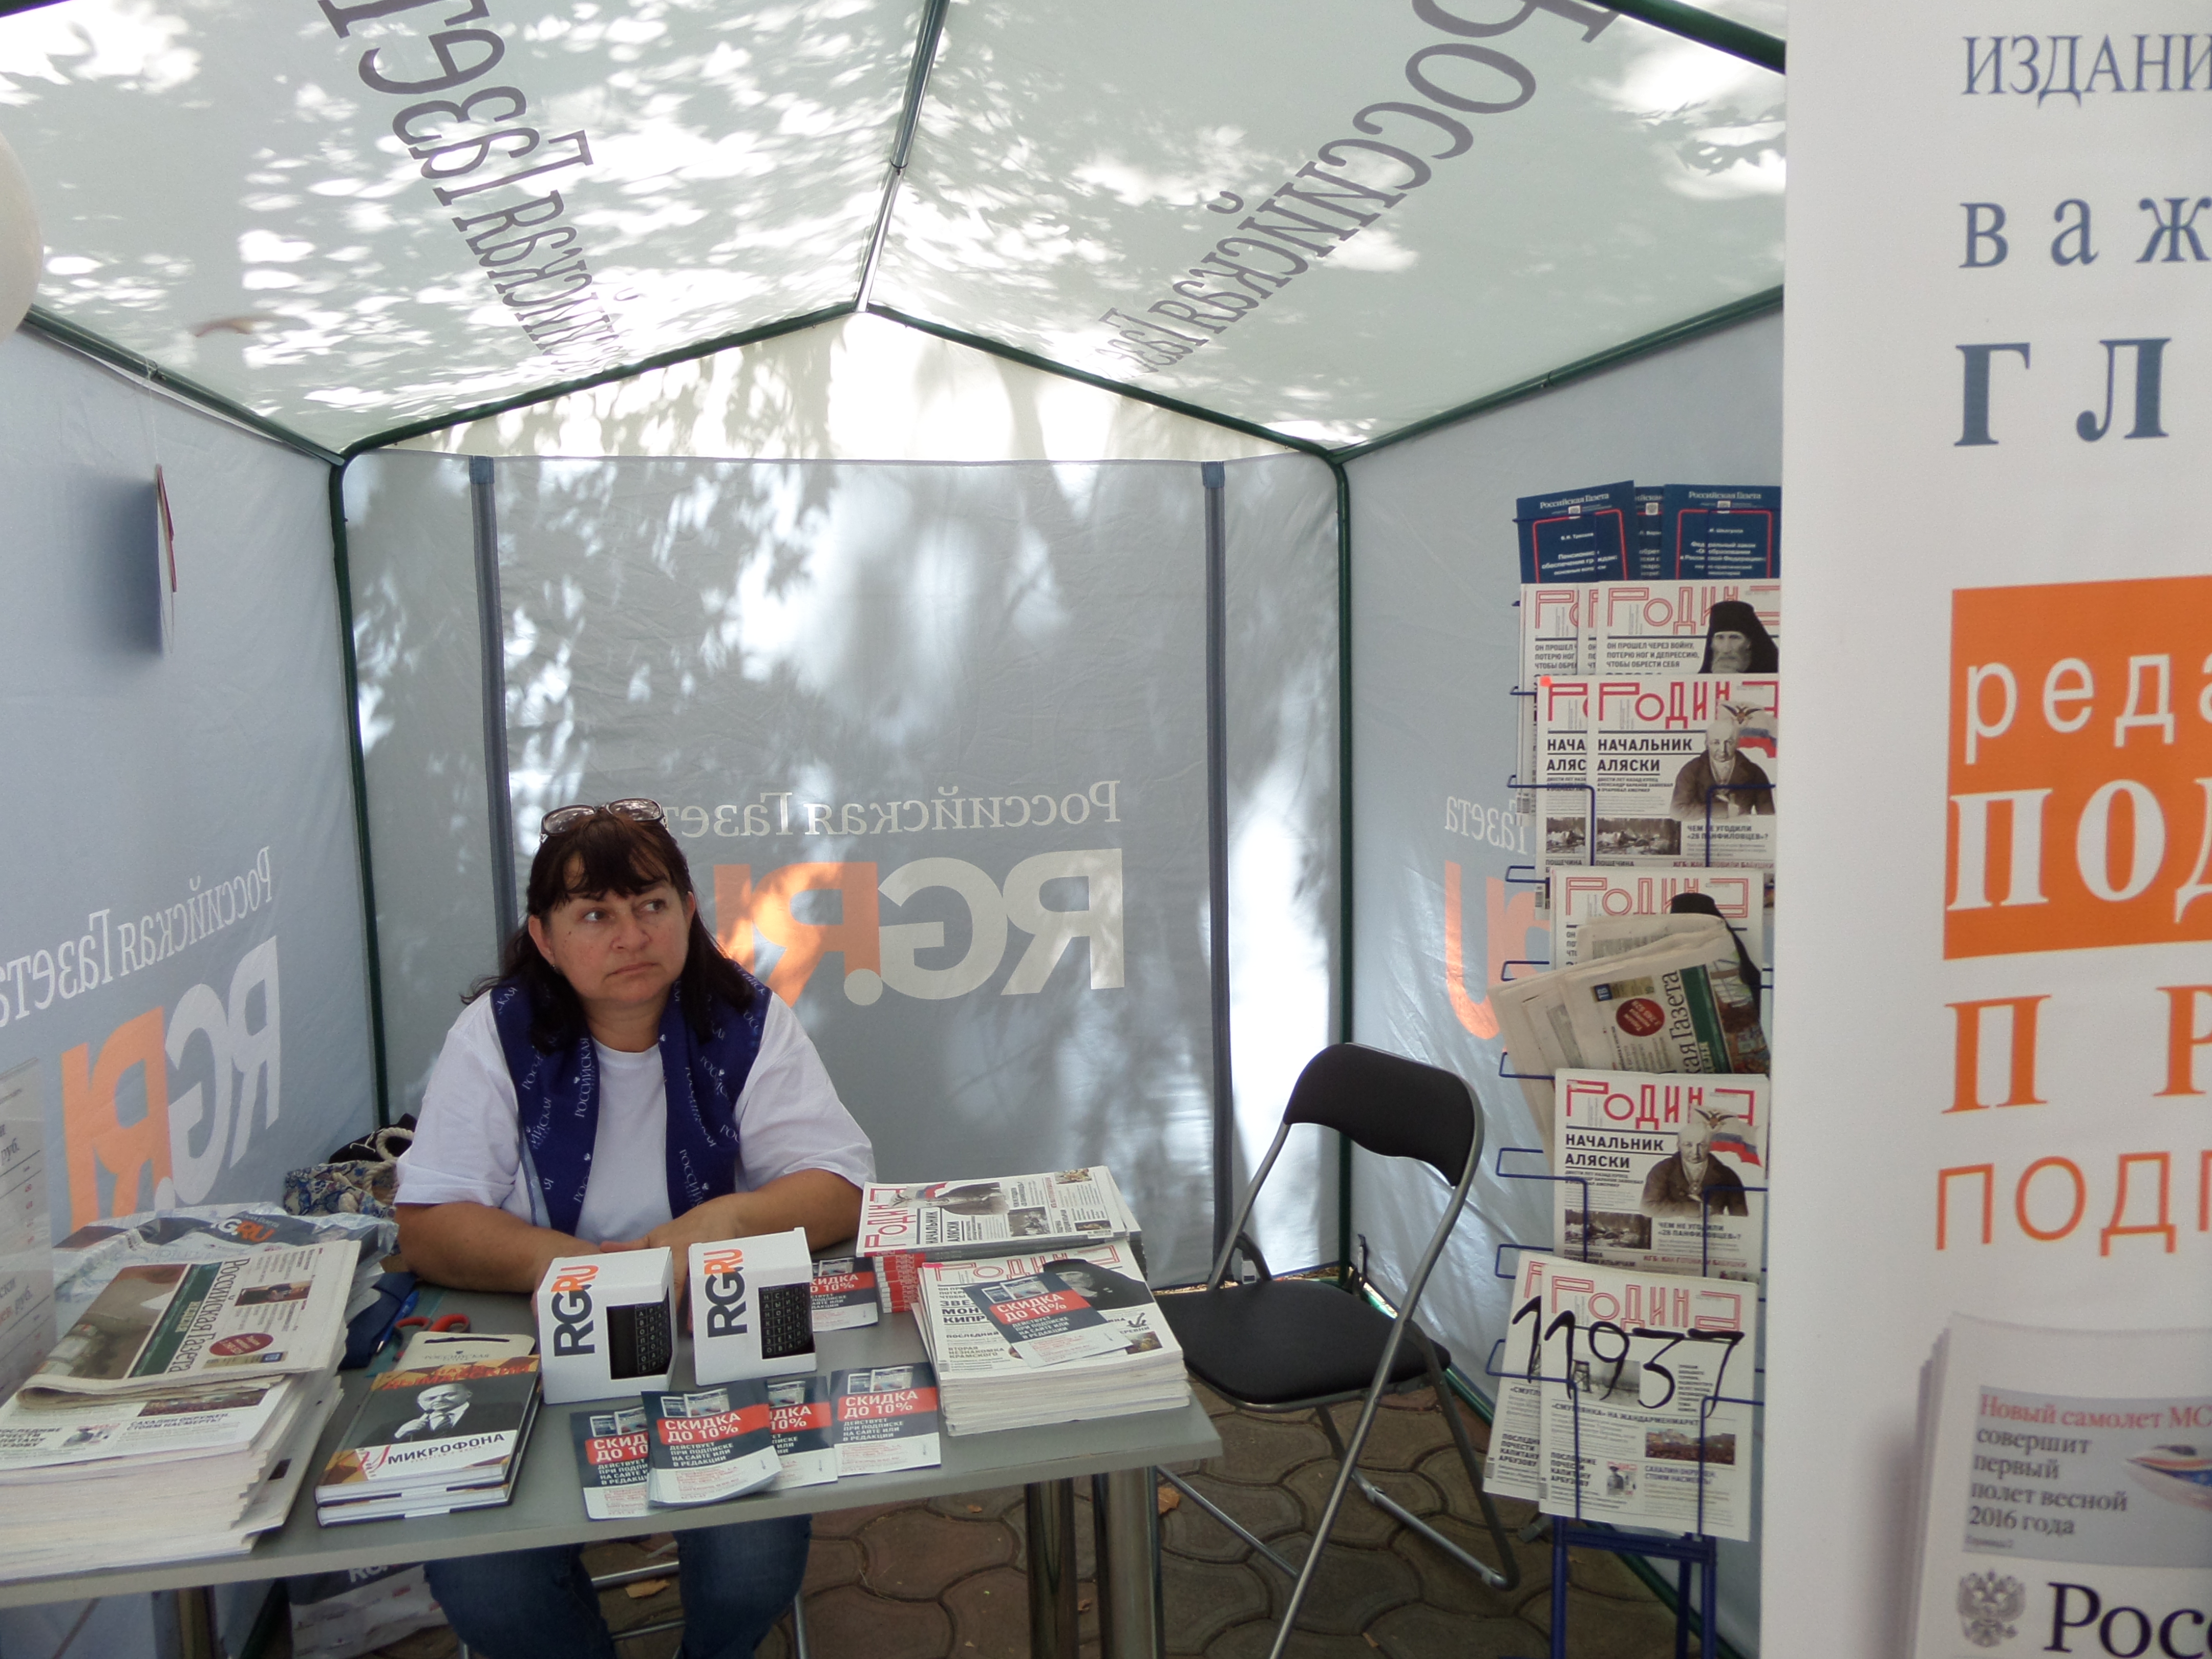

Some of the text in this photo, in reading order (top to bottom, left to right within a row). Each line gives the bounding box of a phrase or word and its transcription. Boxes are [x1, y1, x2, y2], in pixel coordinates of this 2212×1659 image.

[1598, 738, 1693, 752] НАЧАЛЬНИК
[1597, 759, 1661, 772] АЛЯСКИ
[1662, 970, 1693, 1040] Газета
[1565, 1133, 1664, 1152] НАЧАЛЬНИК
[1564, 1153, 1631, 1169] АЛЯСКИ
[925, 1210, 939, 1245] НАЧАЛЬНИК
[947, 1220, 960, 1243] АЛЯСКИ
[190, 1258, 251, 1332] Российская
[823, 1282, 855, 1291] 10%
[997, 1293, 1065, 1313] СКИДКА
[1005, 1302, 1067, 1323] ДО 10%
[1030, 1325, 1052, 1334] САЙТЕ
[1053, 1321, 1070, 1330] ИЛИ
[1032, 1316, 1070, 1328] ПОДПИСКЕ
[1029, 1326, 1068, 1338] РЕДАКЦИИ
[167, 1332, 217, 1373] Газета
[845, 1390, 919, 1407] СКИДКА
[844, 1401, 913, 1419] ДО 10%
[1980, 1393, 2056, 1426] Новый
[2060, 1409, 2163, 1429] самолет
[665, 1411, 741, 1431] СКИДКА
[771, 1417, 807, 1431] 10%
[844, 1418, 888, 1427] ДЕЙСТВУЕТ
[861, 1420, 904, 1430] ПОДПИСКЕ
[668, 1423, 739, 1443] ДО 10%
[850, 1432, 894, 1441] РЕДАКЦИИ
[1975, 1428, 2092, 1456] совершит
[388, 1433, 505, 1465] МИКРОФОНА
[669, 1441, 715, 1451] ДЕЙСТВУЕТ
[690, 1442, 734, 1455] ПОДПИСКЕ
[596, 1450, 623, 1463] ДО
[680, 1456, 727, 1466] РЕДАКЦИИ
[685, 1452, 713, 1460] САЙТЕ
[1973, 1454, 2059, 1480] первый
[1971, 1482, 2129, 1512] полет весной
[1968, 1505, 2075, 1538] 2016 года
[2042, 1581, 2212, 1659] Рос
